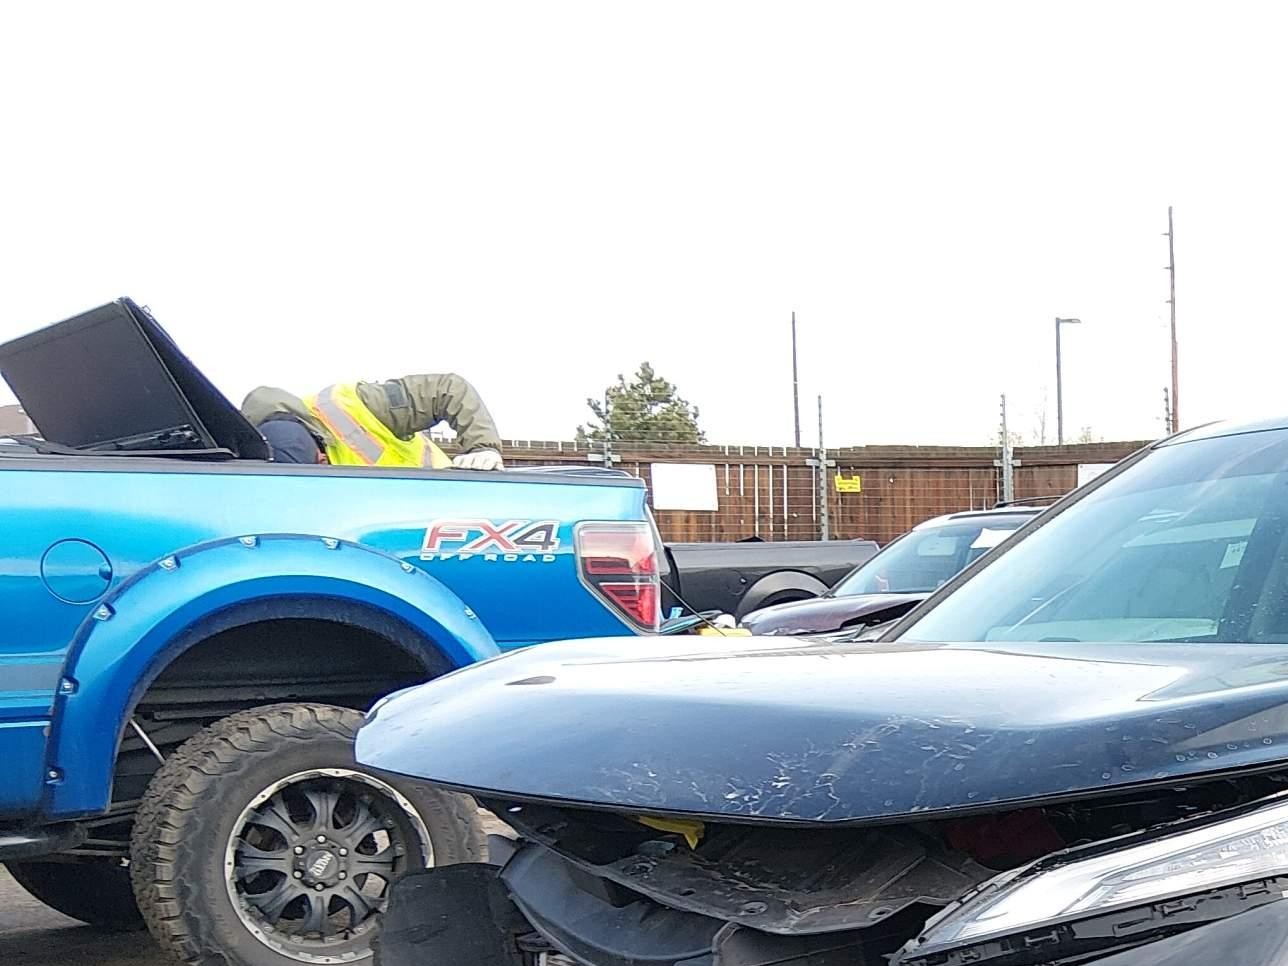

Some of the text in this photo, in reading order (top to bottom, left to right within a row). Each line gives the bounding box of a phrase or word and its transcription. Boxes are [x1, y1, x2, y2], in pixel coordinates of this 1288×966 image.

[421, 518, 561, 553] FX4
[420, 553, 557, 562] OFF ROAD
